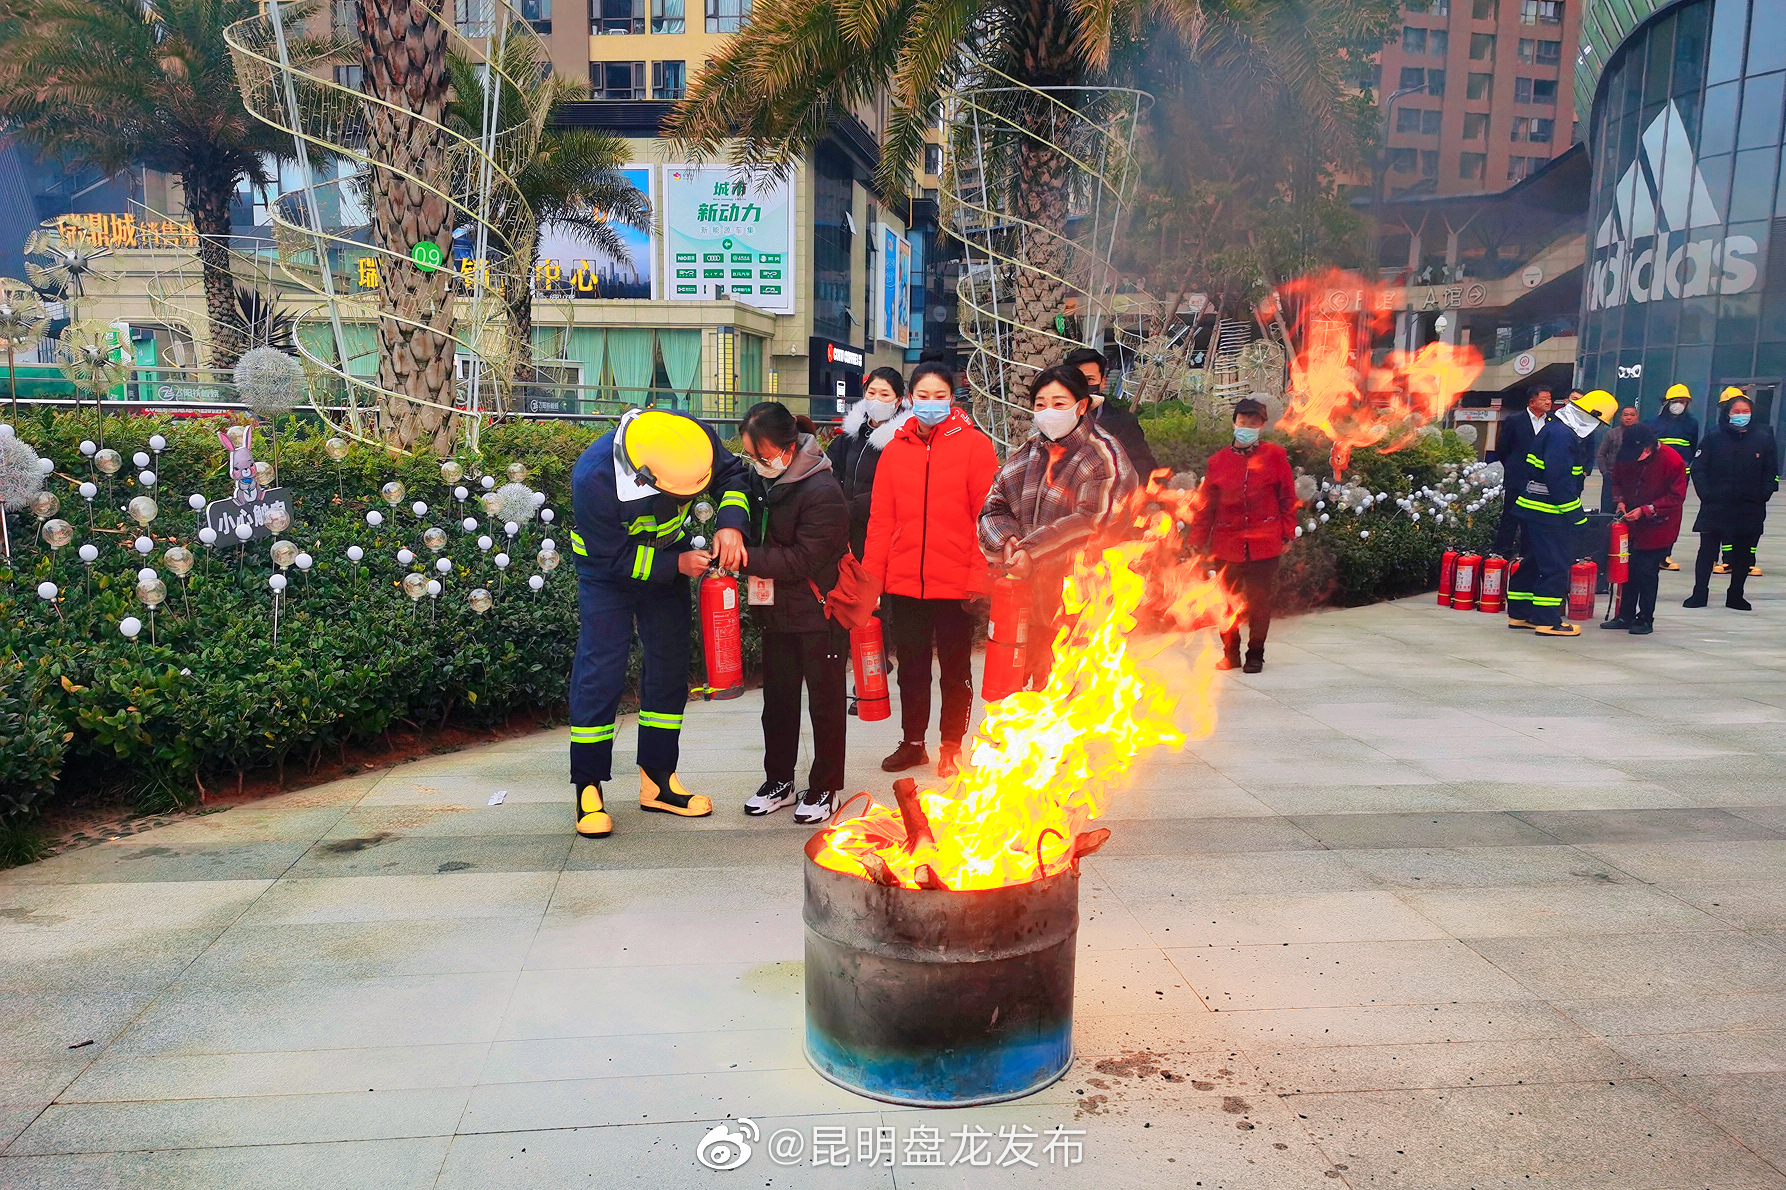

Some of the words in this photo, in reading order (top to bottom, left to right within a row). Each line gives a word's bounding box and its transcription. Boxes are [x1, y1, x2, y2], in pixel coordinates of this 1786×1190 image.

[712, 181, 748, 197] 城市
[697, 202, 762, 223] 新动力
[414, 246, 440, 267] 09
[1586, 230, 1758, 313] adidas
[1422, 286, 1463, 309] A馆
[1056, 317, 1065, 330] 08
